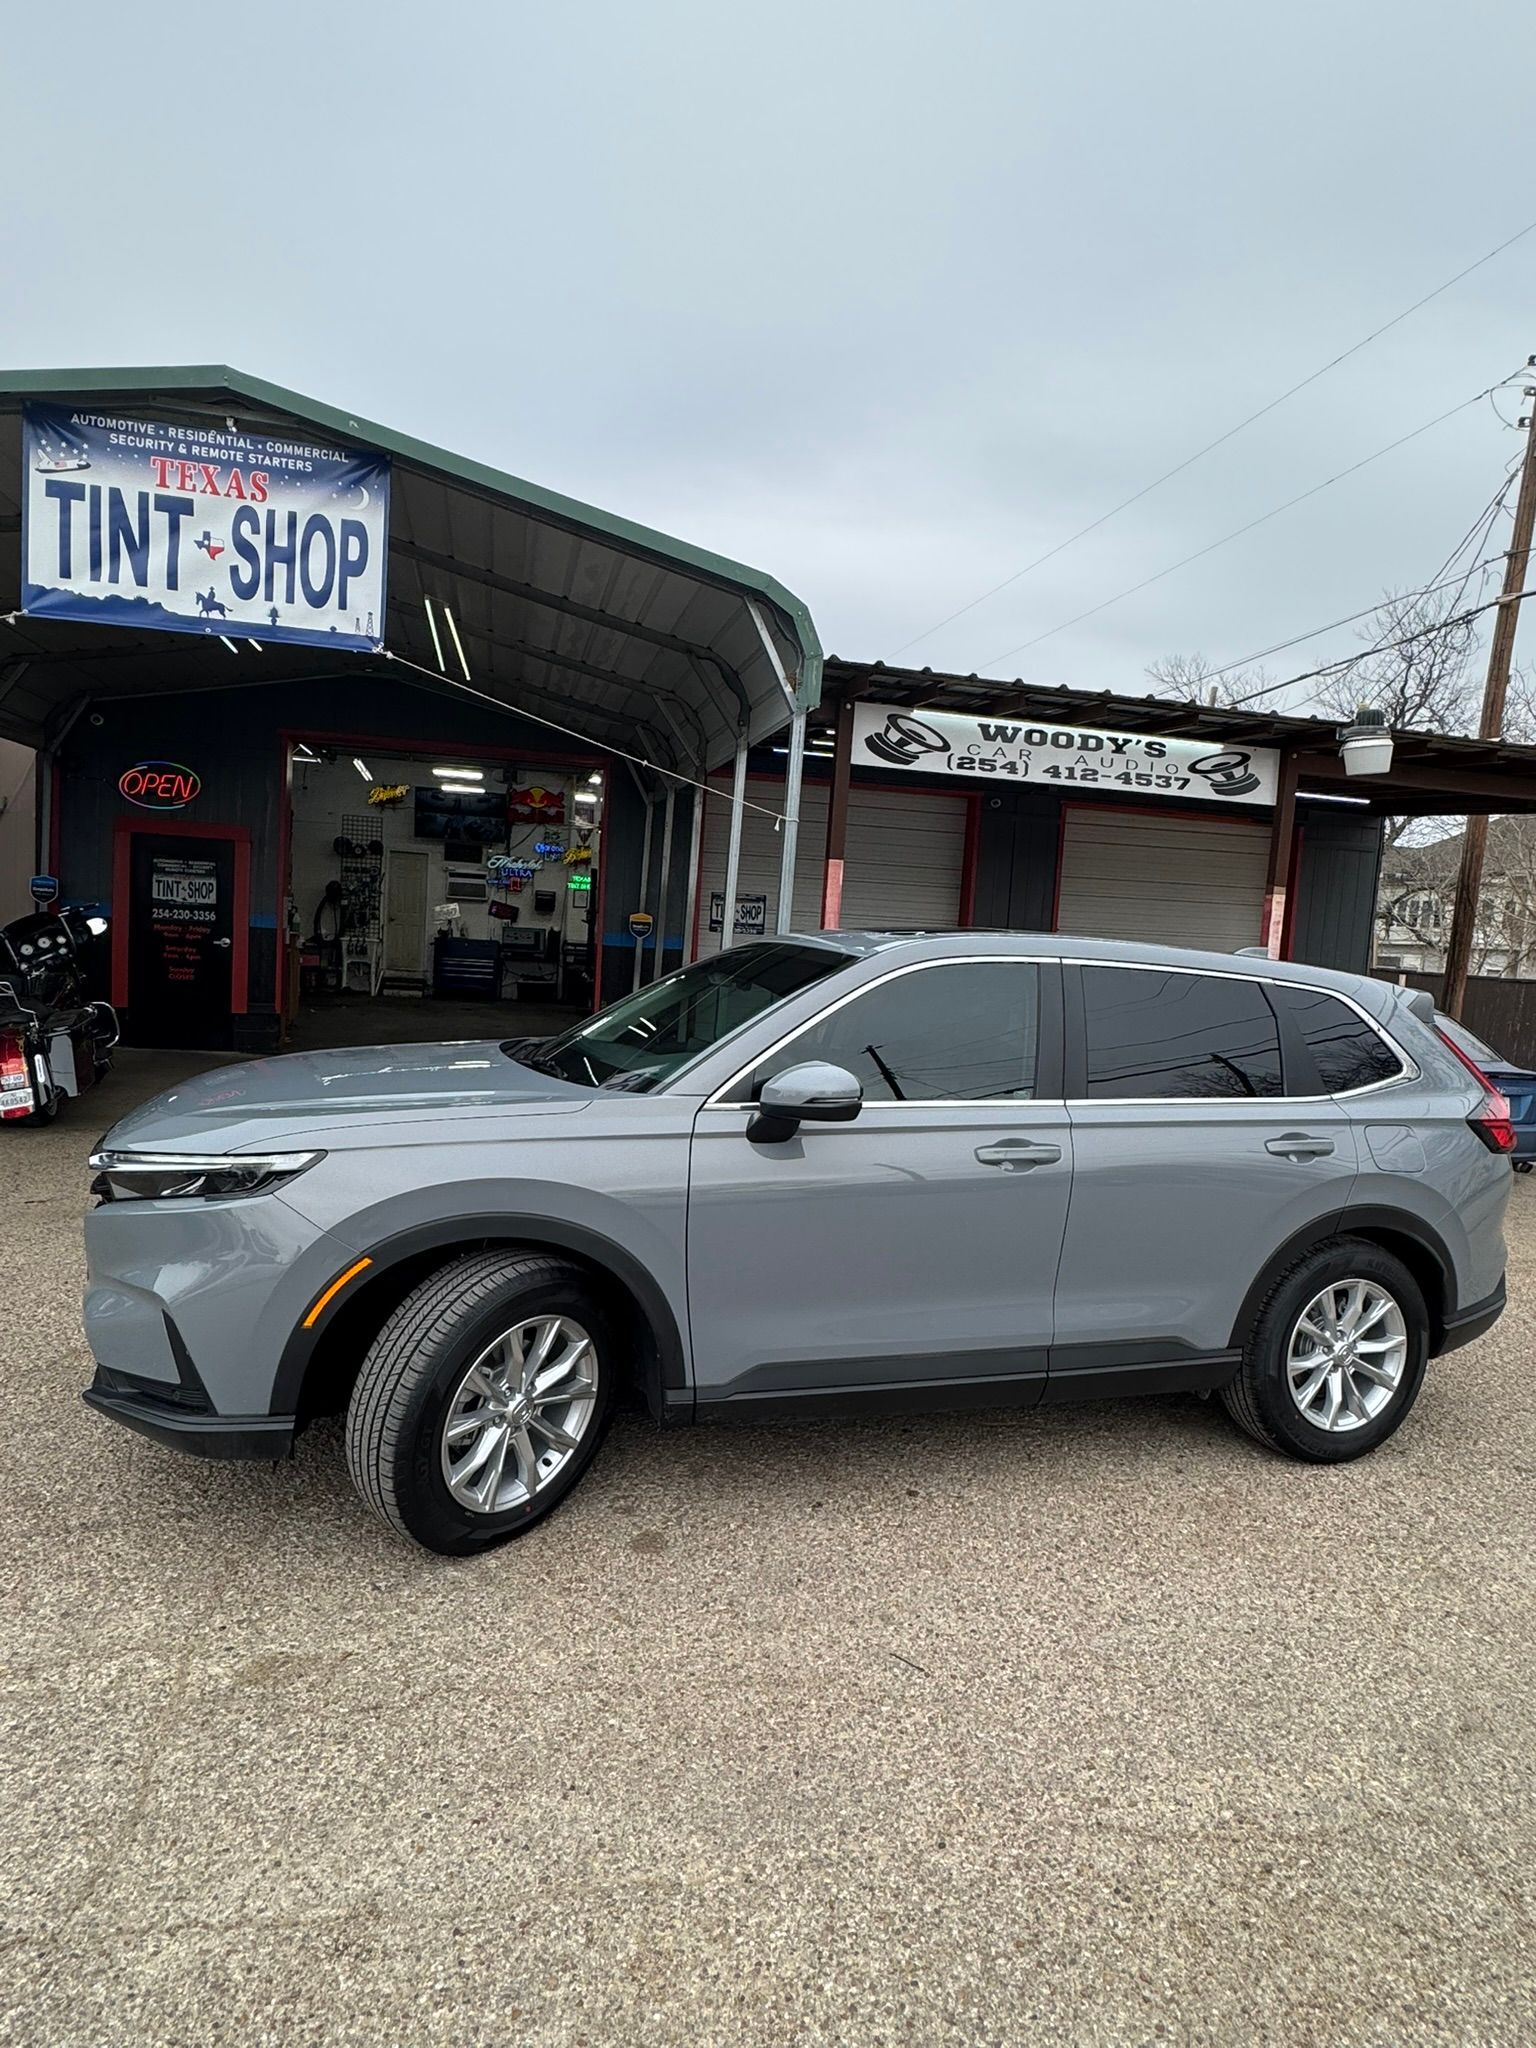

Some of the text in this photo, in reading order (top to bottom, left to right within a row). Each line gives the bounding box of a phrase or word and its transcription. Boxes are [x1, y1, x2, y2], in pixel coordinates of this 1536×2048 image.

[71, 413, 349, 463] AUTOMOTIVE RESIDENTIAL COMMERCIAL
[109, 433, 312, 472] SECURITY & REMOTE STARTERS
[150, 456, 270, 503] TEXAS
[45, 478, 369, 611] TINT SHOP
[977, 722, 1168, 759] WOODY'S
[947, 753, 1191, 791] (254) 412-4537
[966, 743, 1179, 775] CAR AUDIO
[124, 772, 194, 798] OPEN
[155, 879, 214, 899] TINT SHOP
[501, 868, 533, 878] ULTRA
[151, 908, 217, 921] 254-230-3356
[740, 904, 762, 921] SHOP
